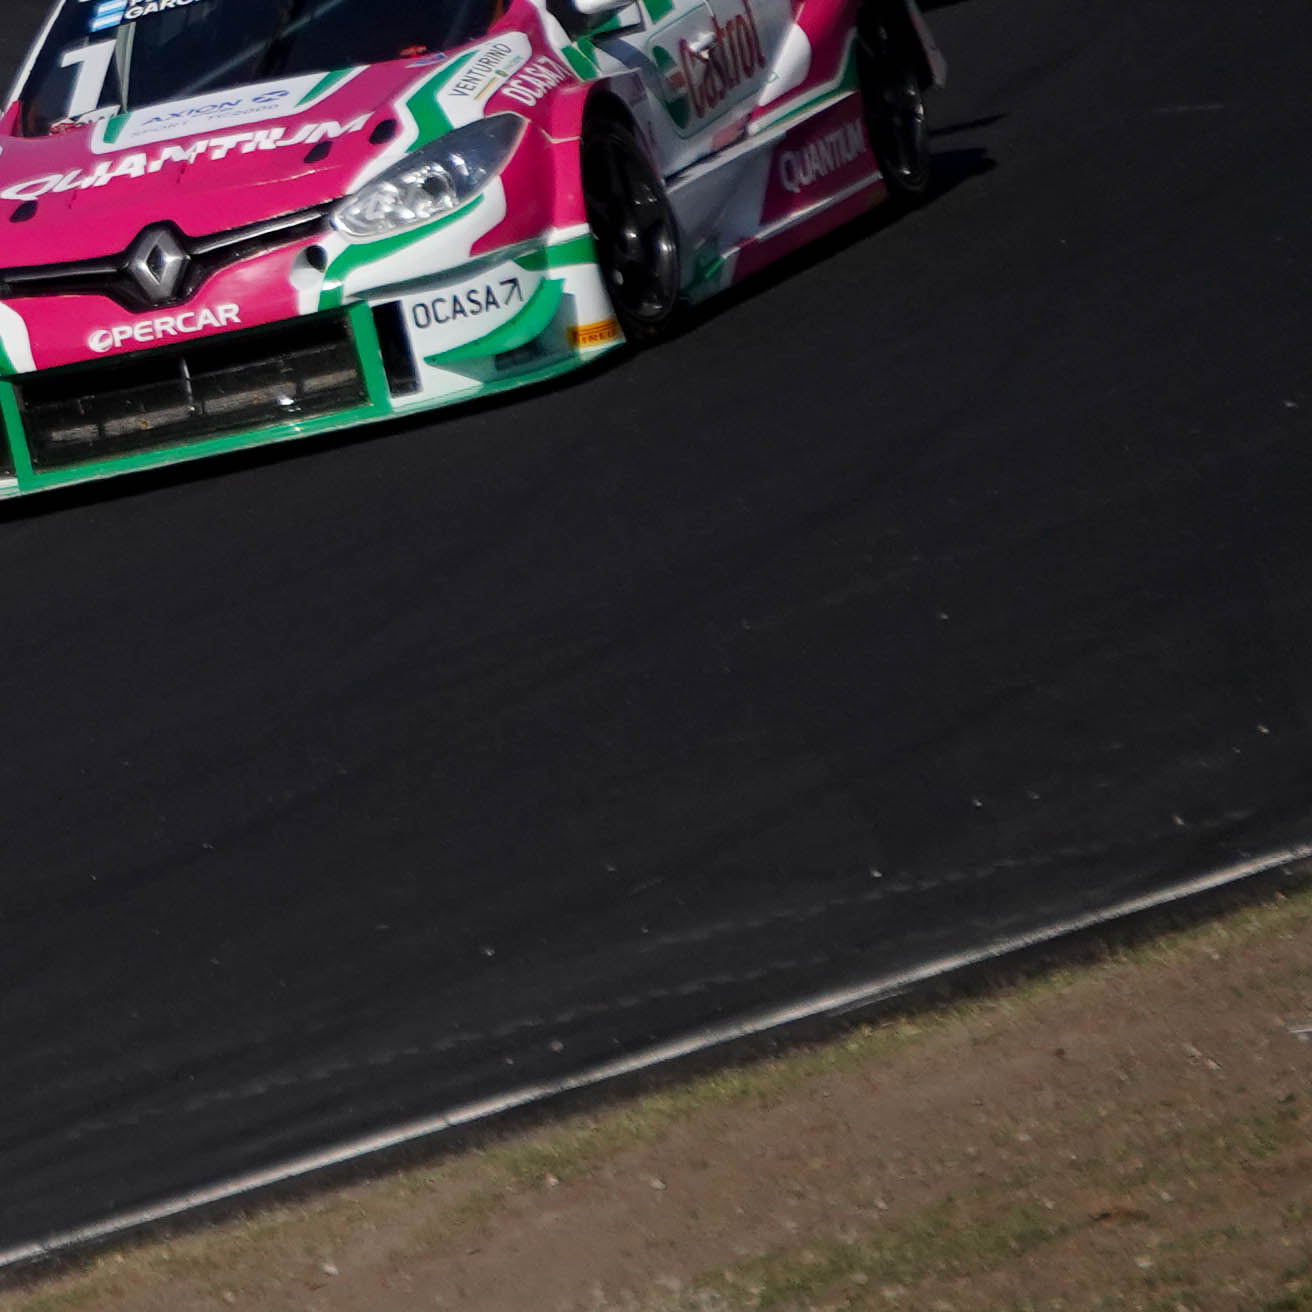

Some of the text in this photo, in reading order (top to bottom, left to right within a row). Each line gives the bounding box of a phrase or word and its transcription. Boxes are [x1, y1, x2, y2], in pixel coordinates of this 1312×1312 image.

[59, 38, 118, 119] 1
[448, 42, 513, 97] VENTURINO
[0, 111, 374, 201] QUANTIUM
